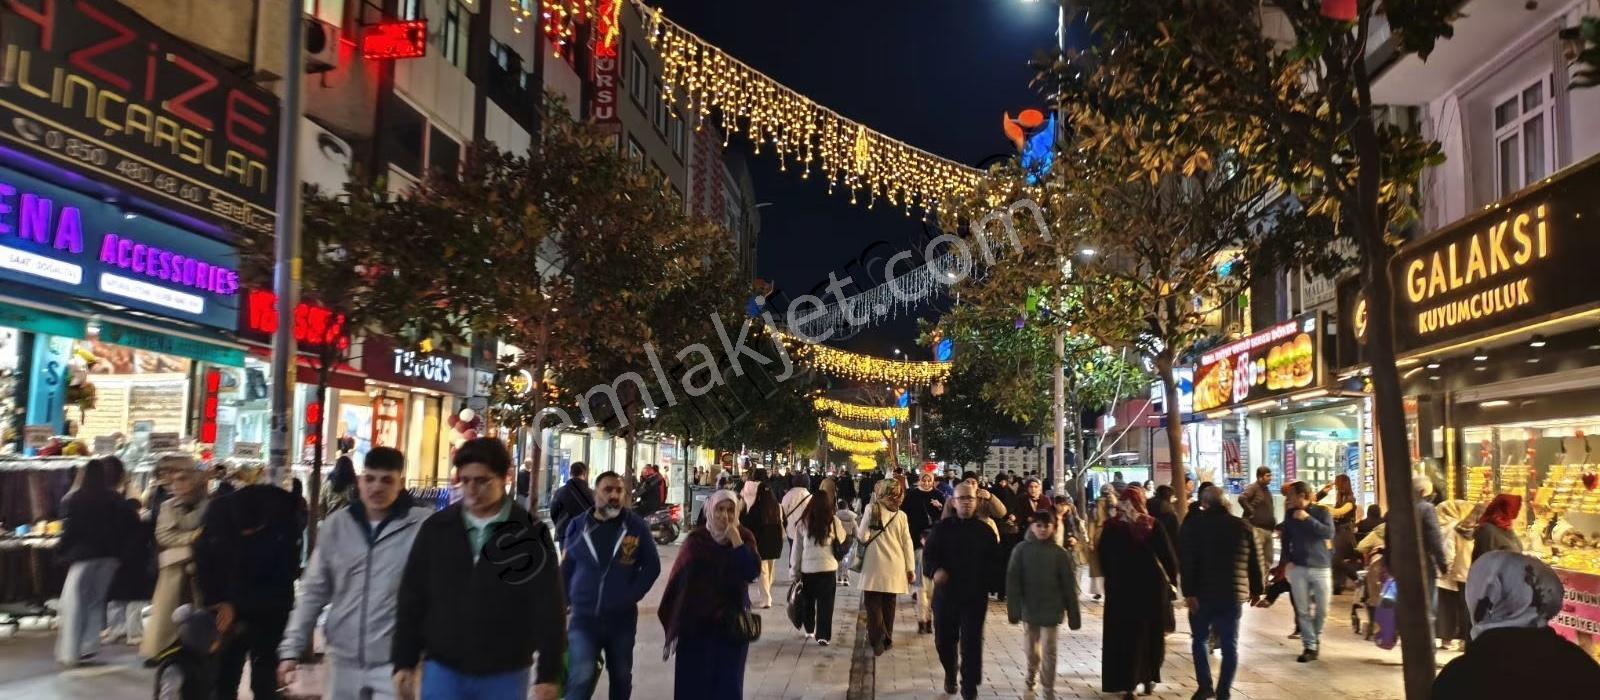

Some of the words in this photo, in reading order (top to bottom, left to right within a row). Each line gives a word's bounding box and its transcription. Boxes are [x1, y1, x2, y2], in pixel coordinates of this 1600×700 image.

[66, 138, 108, 165] 850
[154, 173, 179, 193] 68
[100, 233, 240, 295] ACCESSORIES
[1418, 278, 1530, 334] KUYUMCULUK
